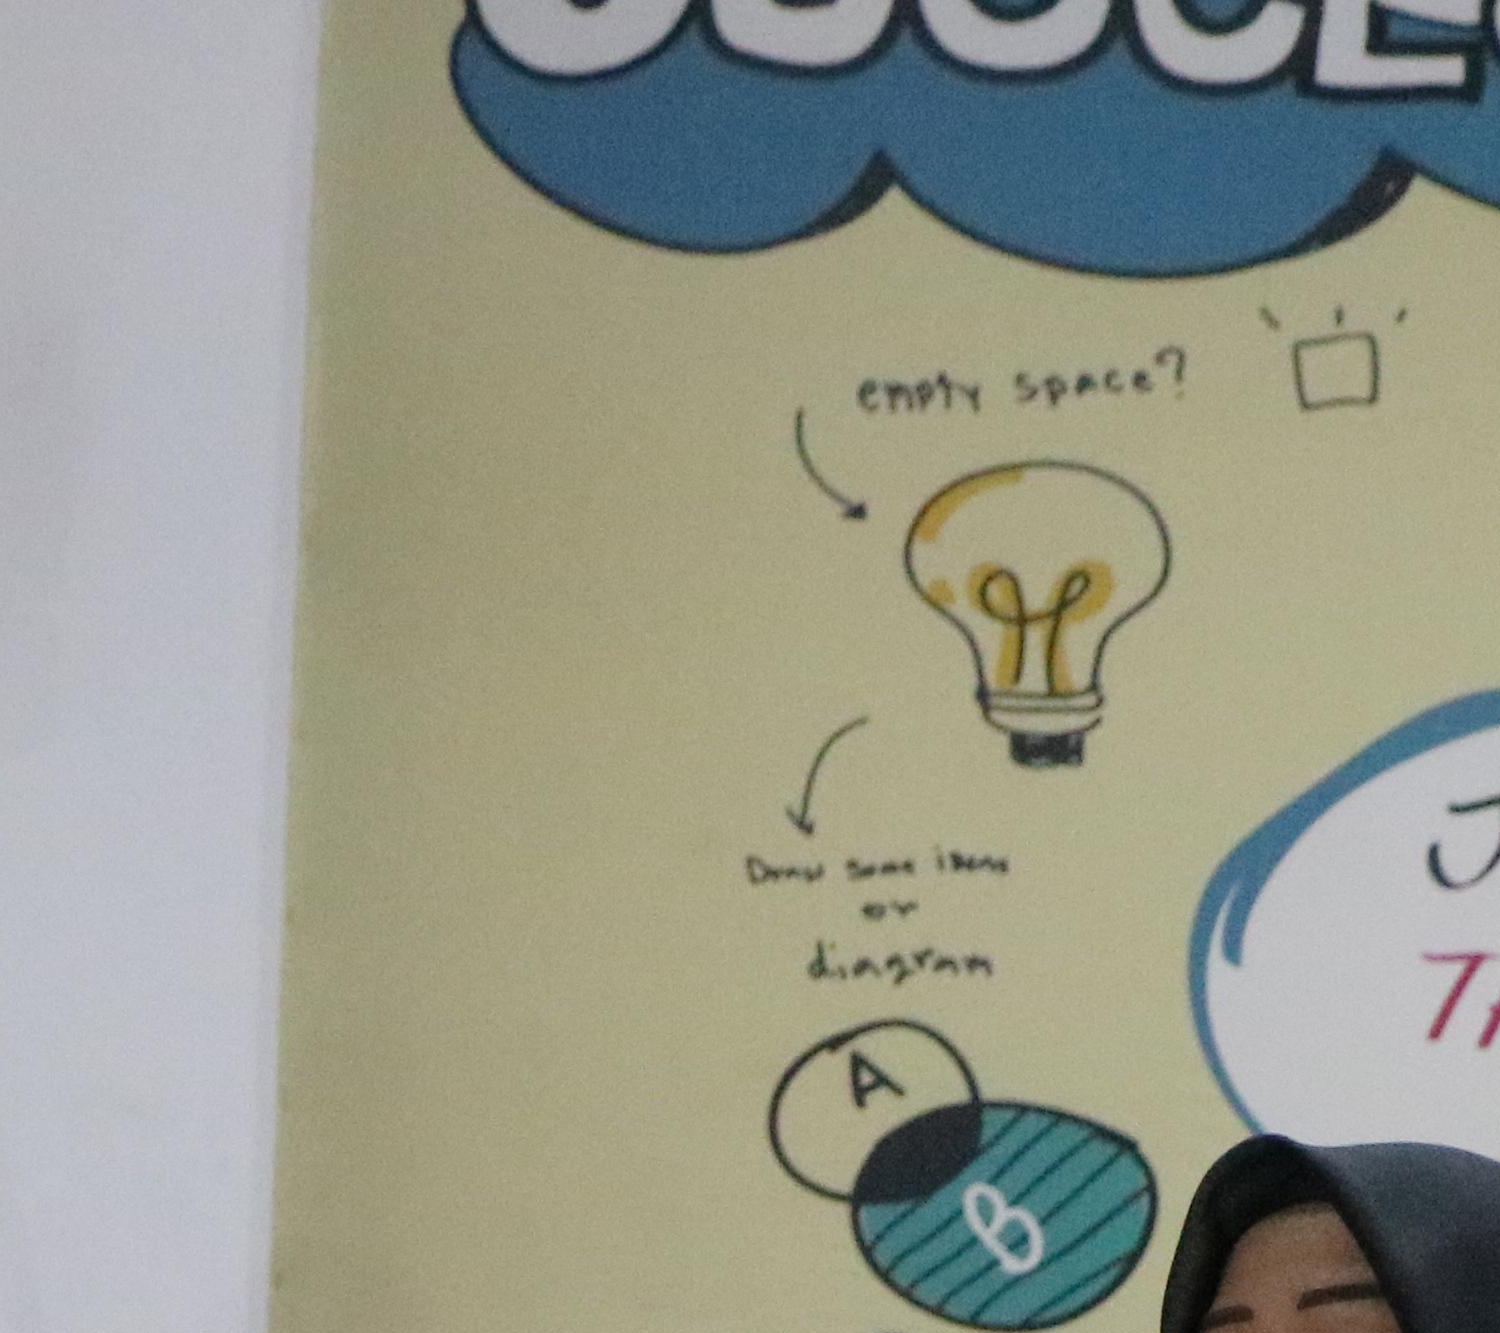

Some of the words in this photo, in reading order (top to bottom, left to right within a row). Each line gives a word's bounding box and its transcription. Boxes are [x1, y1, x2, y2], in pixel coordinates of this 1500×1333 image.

[856, 370, 981, 414] empty
[1013, 344, 1188, 408] space?
[860, 900, 920, 921] or
[806, 938, 994, 987] diagram
[847, 1049, 906, 1109] A
[962, 1182, 1045, 1275] B
